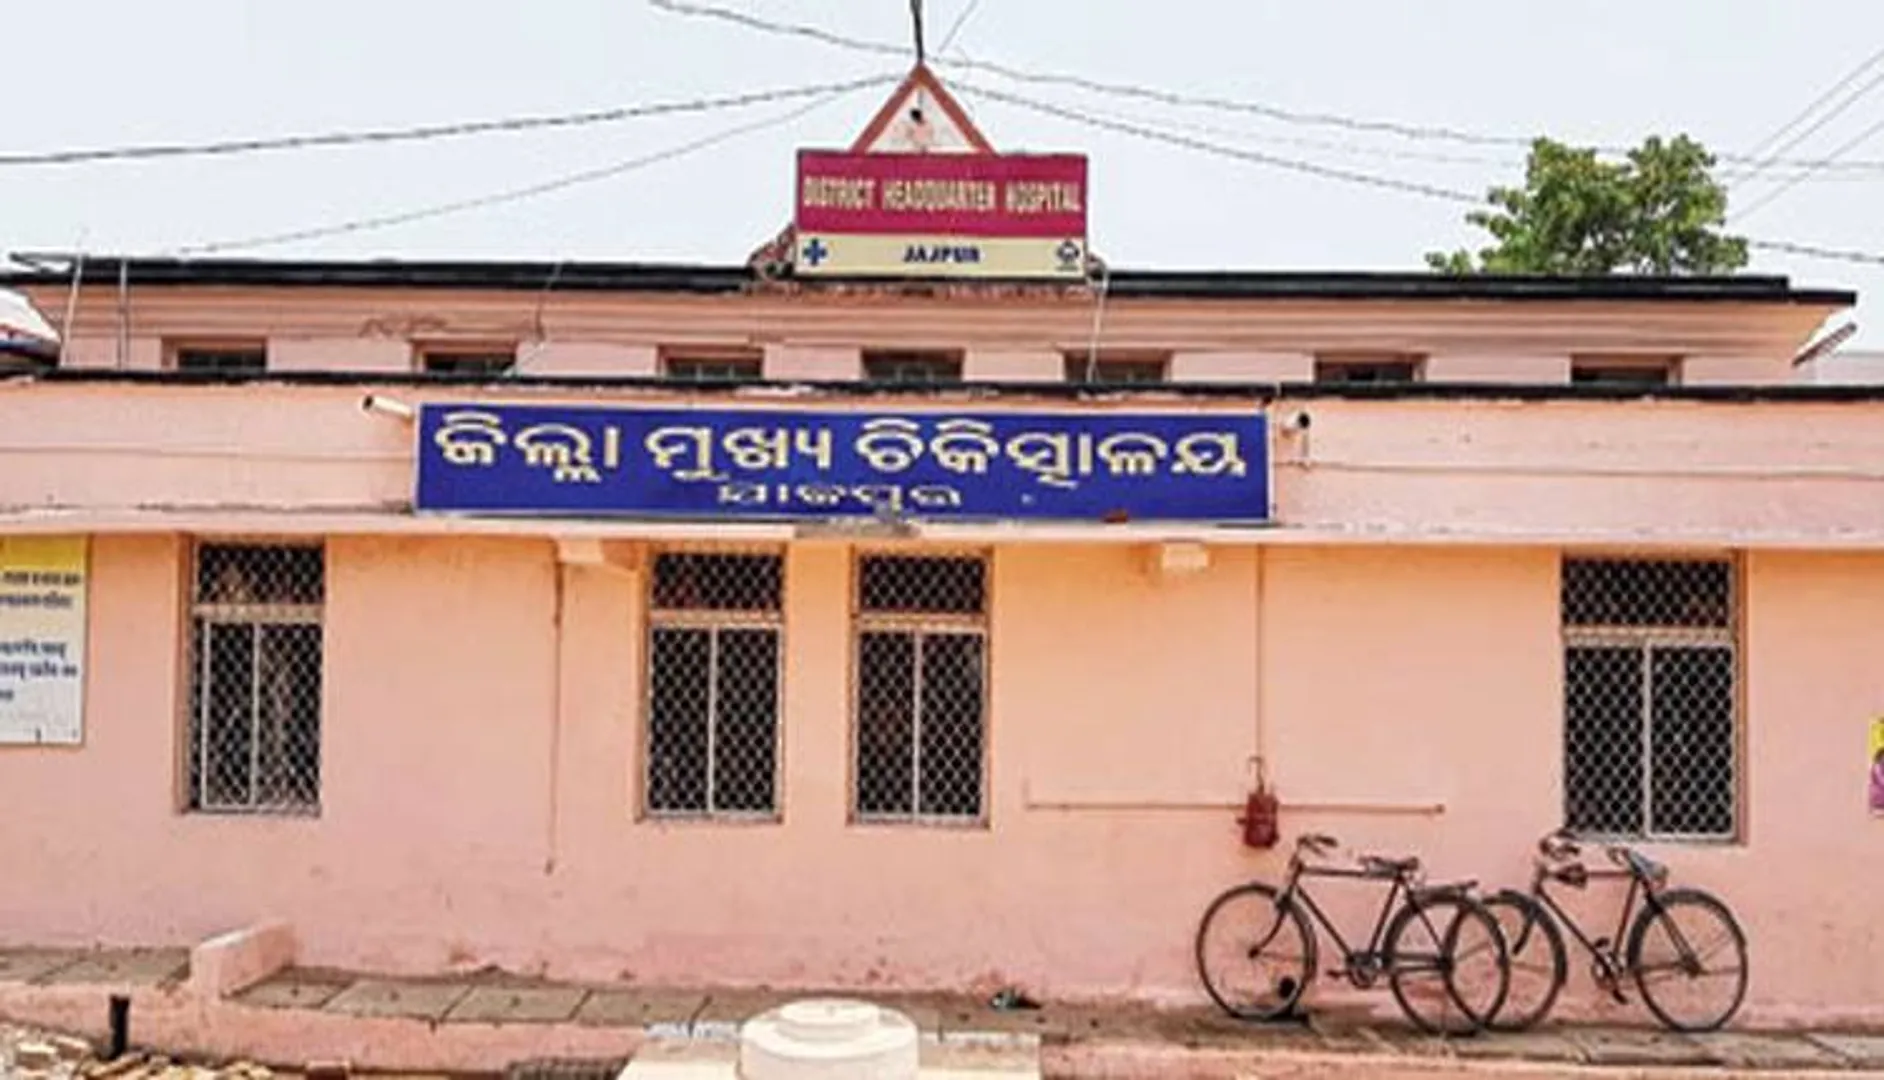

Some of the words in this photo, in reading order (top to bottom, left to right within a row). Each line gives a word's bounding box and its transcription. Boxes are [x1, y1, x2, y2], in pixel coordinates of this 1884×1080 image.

[803, 176, 876, 209] DISTRICT
[881, 178, 996, 211] HEADQUARTER
[1004, 181, 1081, 213] HOSPITAL
[902, 245, 981, 263] JAJPUR
[434, 410, 620, 483] ଜିଲ୍ଲା
[645, 424, 833, 483] ମୁଖ୍ୟ
